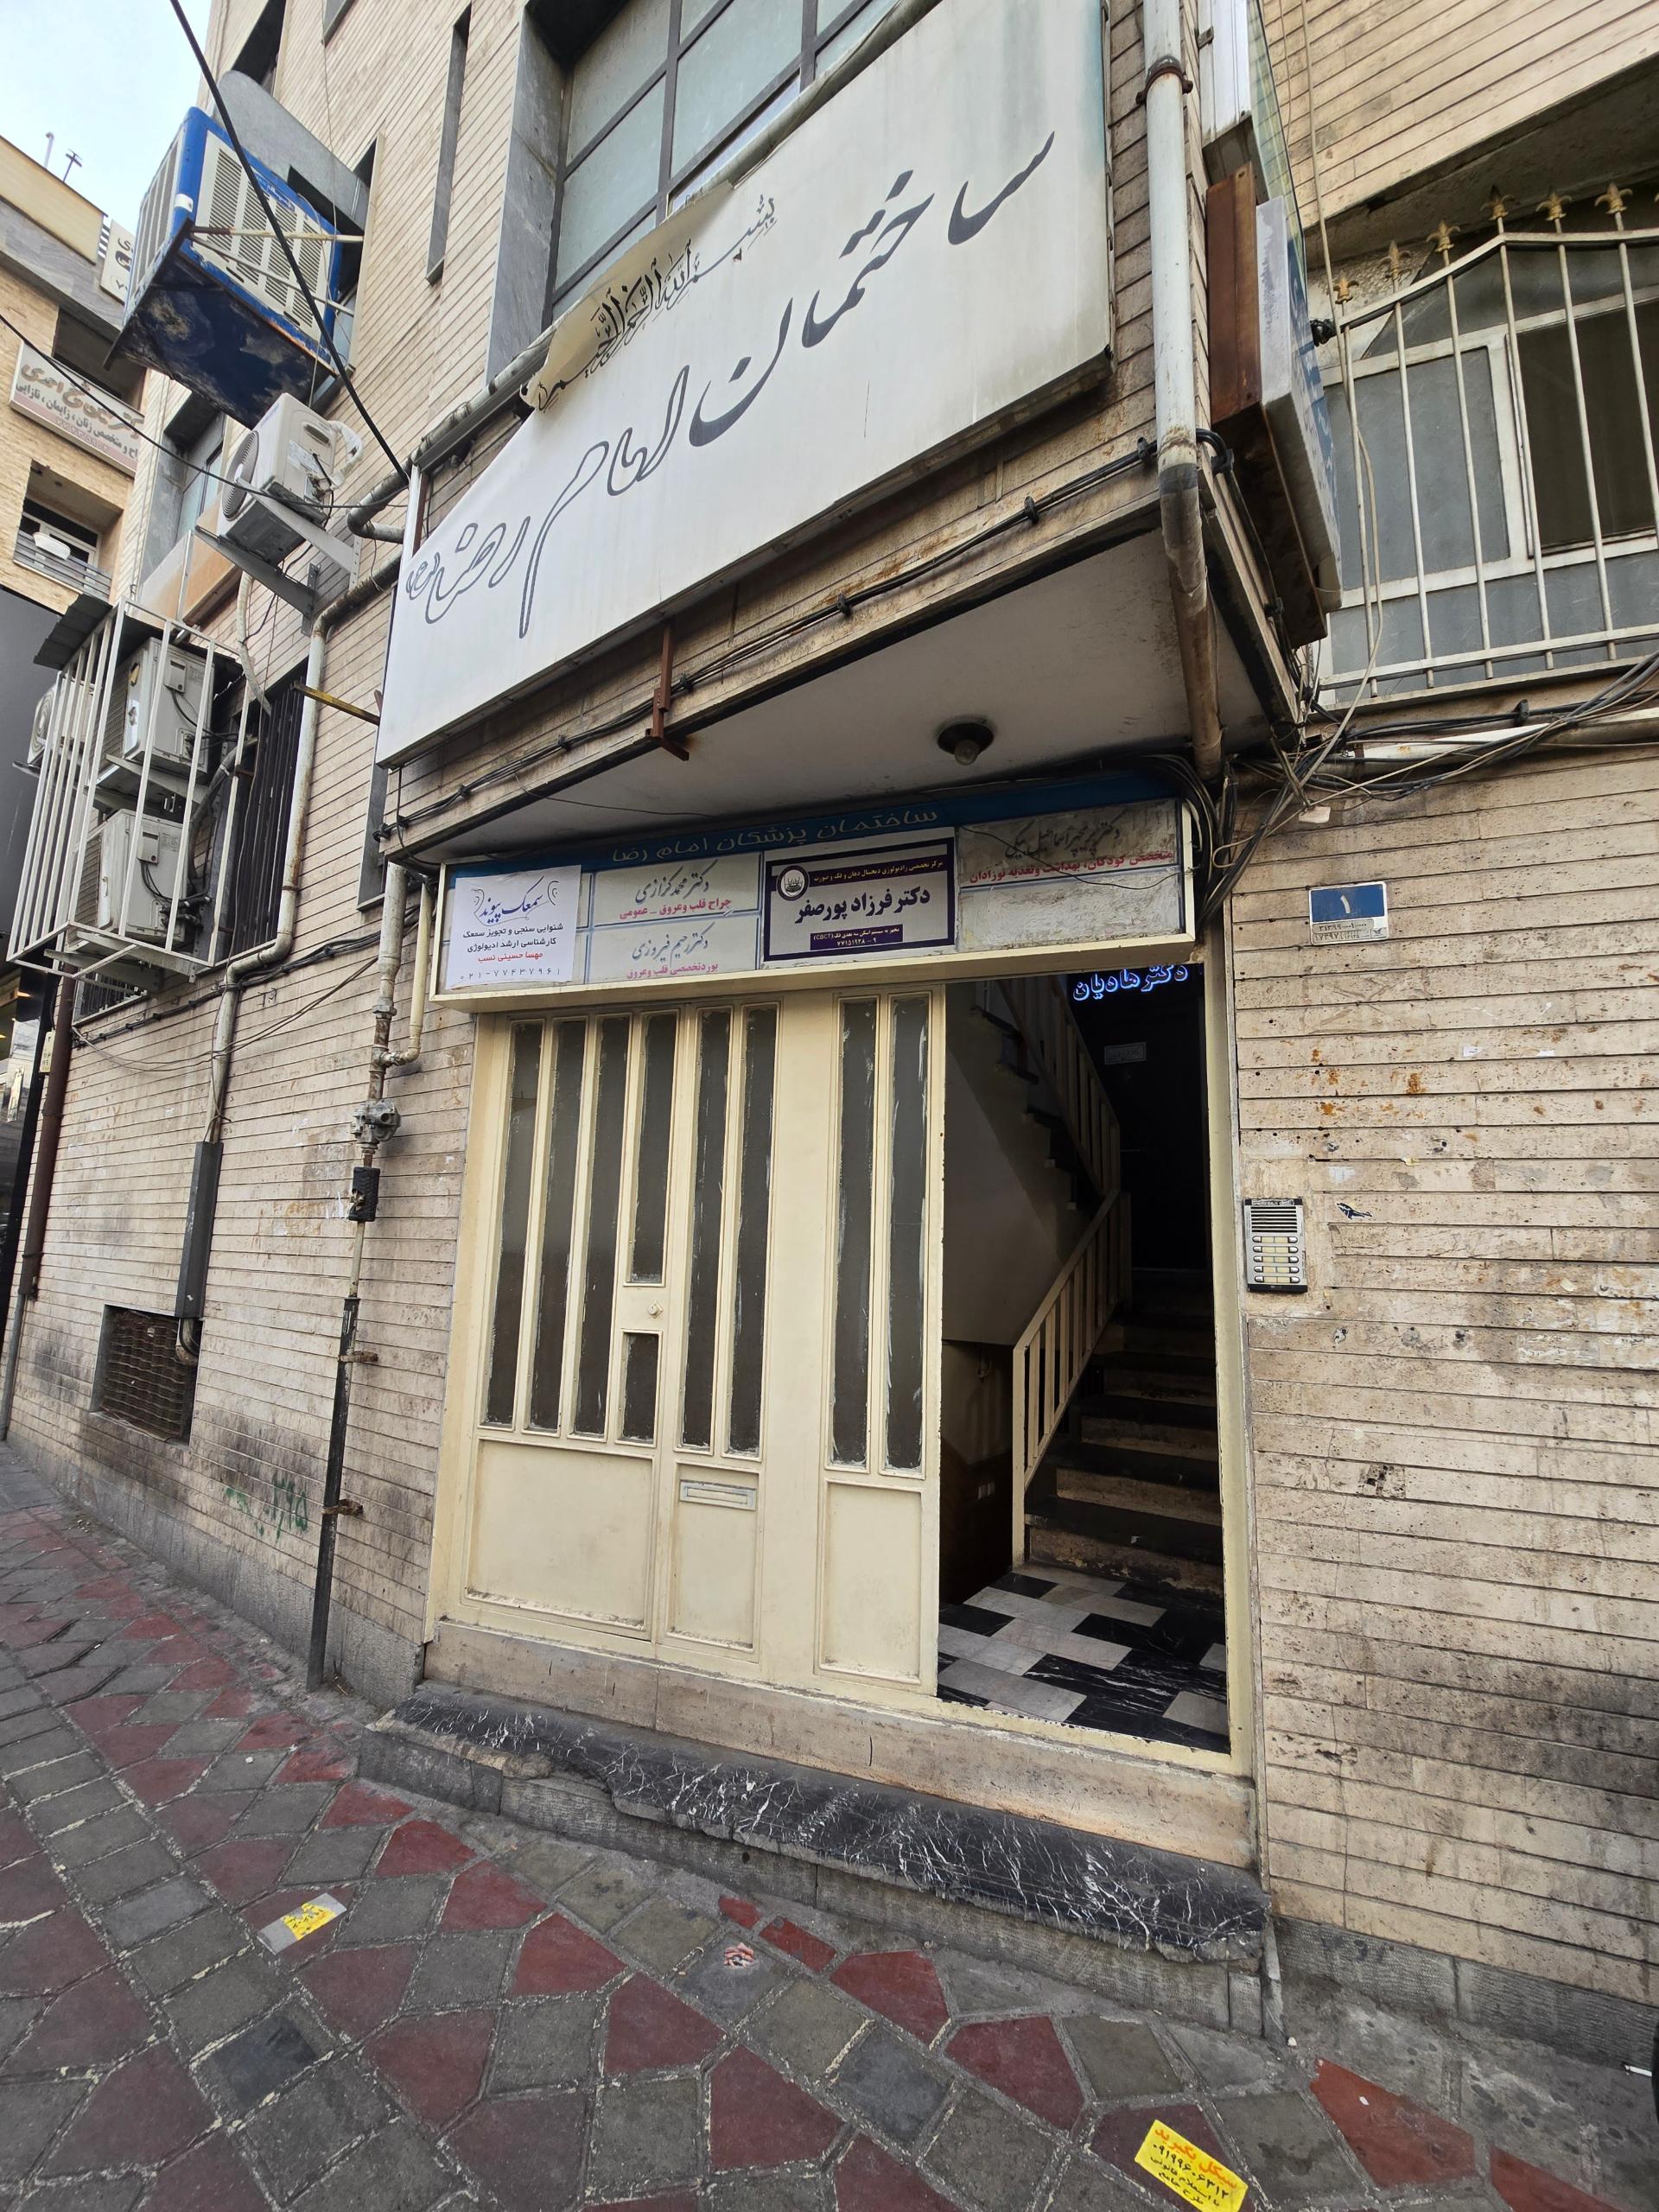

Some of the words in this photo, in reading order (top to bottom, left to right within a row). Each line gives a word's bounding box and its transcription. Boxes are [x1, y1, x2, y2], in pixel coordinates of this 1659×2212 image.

[688, 130, 1055, 448] ساختمان
[518, 364, 690, 639] امام
[424, 515, 531, 625] رضا
[817, 808, 938, 839] ساختمان
[715, 823, 808, 852] پزشکان
[612, 848, 648, 863] رضا
[655, 836, 709, 859] امام
[931, 860, 944, 869] مرکز
[1129, 849, 1173, 866] متخصص
[847, 870, 861, 879] دهان
[909, 862, 930, 872] تخصصی
[683, 859, 719, 900] دکتر
[969, 868, 1007, 884] نوزادان
[501, 874, 545, 916] سمعک
[671, 877, 688, 897] محمد
[689, 898, 707, 912] قلب
[708, 897, 733, 910] جراح
[850, 888, 893, 917] فرزاد
[893, 886, 931, 914] دکتر
[1340, 894, 1351, 914] ۱
[479, 896, 502, 925] پیوند
[620, 906, 648, 920] عمومی
[462, 931, 486, 939] سمعک
[486, 929, 507, 938] تجویز
[513, 927, 536, 937] سنجی
[537, 922, 564, 934] شنوایی
[499, 939, 519, 950] ارشد
[520, 938, 557, 950] کارشناسی
[689, 921, 716, 954] دکتر
[467, 941, 499, 953] ادیولوژی
[524, 950, 544, 960] مهسا
[632, 934, 671, 963] فیروزی
[478, 954, 496, 963] نسب
[497, 952, 524, 962] حسینی
[653, 964, 669, 976] قلب
[1141, 963, 1189, 993] دکتر
[1072, 968, 1141, 1001] هادیان
[1198, 2161, 1237, 2189] سیکل
